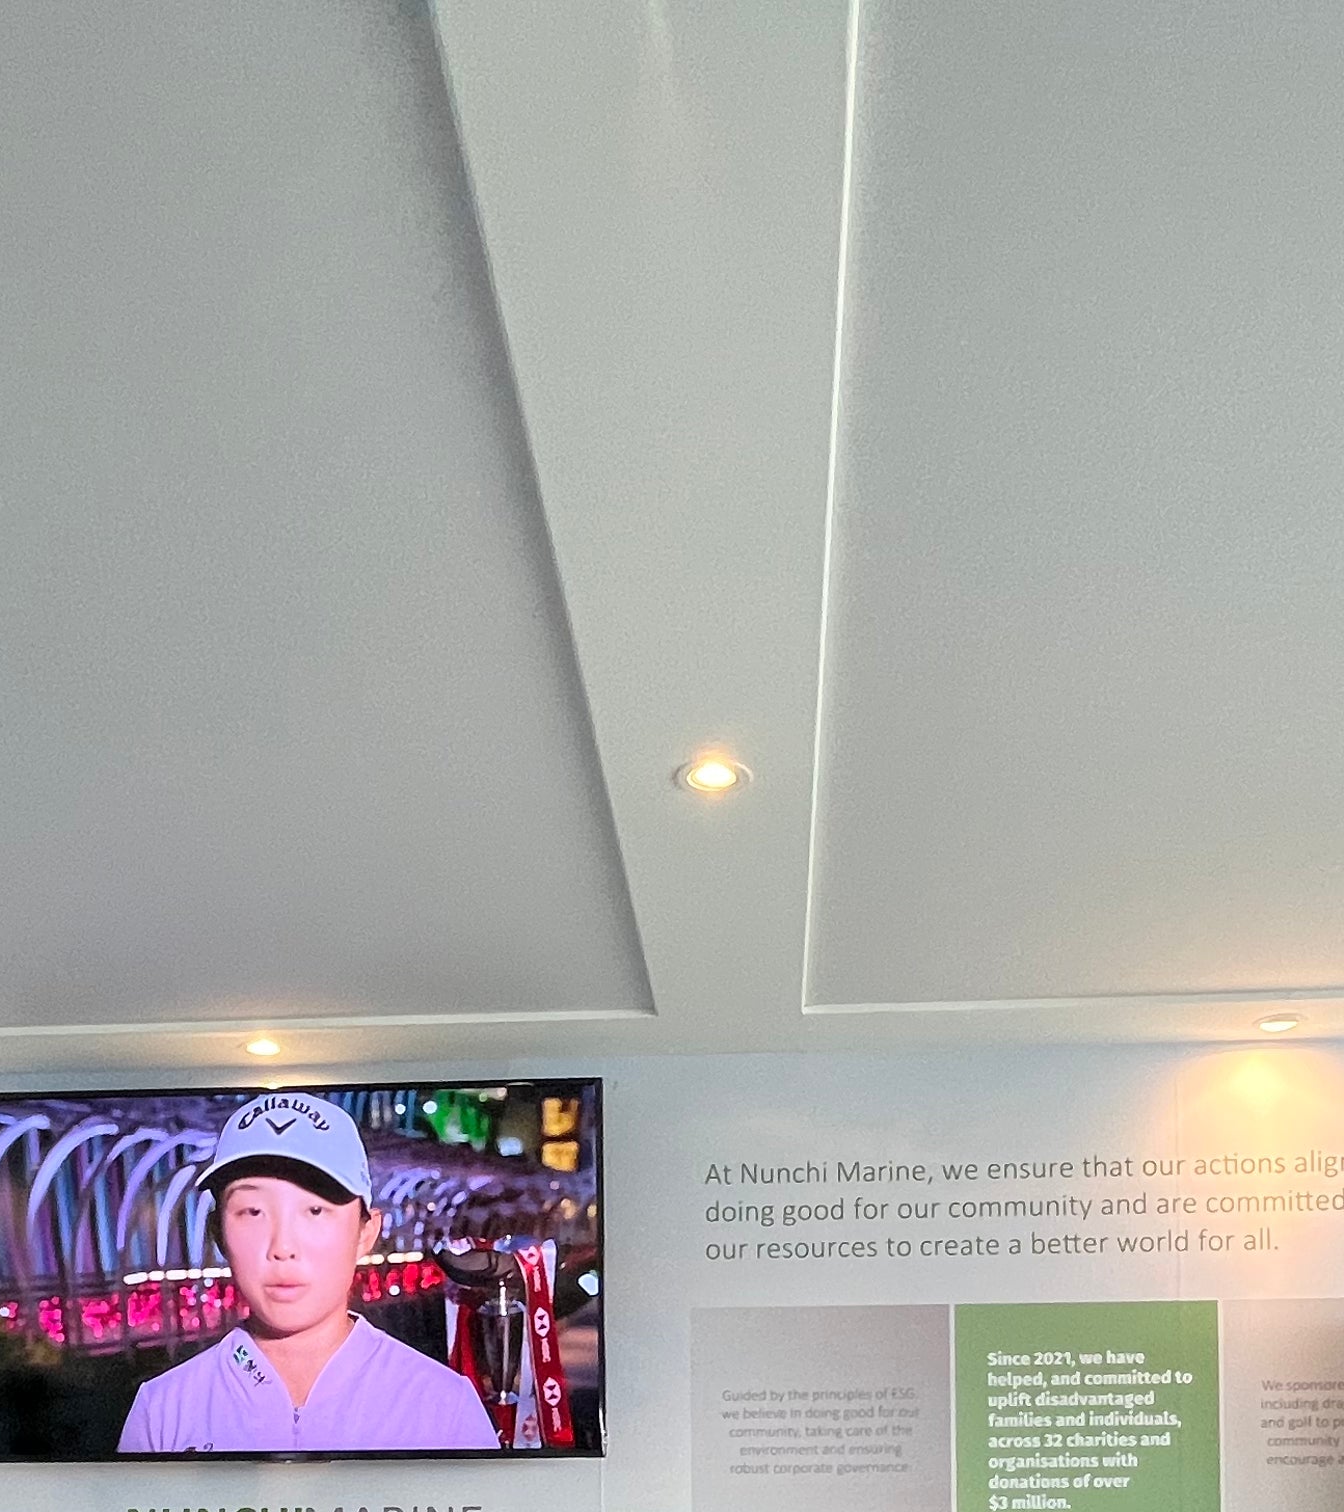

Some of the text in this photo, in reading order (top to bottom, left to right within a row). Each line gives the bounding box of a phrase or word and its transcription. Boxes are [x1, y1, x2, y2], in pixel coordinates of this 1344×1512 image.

[238, 1097, 330, 1132] Callaway
[705, 1163, 731, 1184] At
[741, 1161, 827, 1184] Nunchi
[838, 1161, 933, 1186] Marine,
[942, 1163, 978, 1180] we
[988, 1159, 1074, 1179] ensure
[1083, 1155, 1134, 1177] that
[1142, 1159, 1185, 1176] our
[1194, 1152, 1285, 1175] actions
[706, 1199, 774, 1226] doing
[782, 1198, 844, 1226] good
[854, 1197, 888, 1220] for
[898, 1202, 940, 1219] our
[948, 1194, 1092, 1220] community
[1101, 1192, 1147, 1215] and
[1157, 1197, 1197, 1214] are
[706, 1228, 1279, 1260] our resources to create a better world for all.
[987, 1350, 1145, 1367] Since 2021, we have
[988, 1369, 1193, 1388] helped, and committed to
[722, 1389, 766, 1401] Guided
[770, 1390, 785, 1402] by
[788, 1390, 808, 1401] the
[812, 1389, 872, 1402] principles
[988, 1391, 1155, 1409] uplift disadvantaged
[988, 1410, 1181, 1428] families and individuals,
[989, 1431, 1170, 1448] across 32 charities and
[989, 1452, 1138, 1472] organisations with
[989, 1473, 1130, 1488] donations of over
[989, 1494, 1071, 1511] $3 million.
